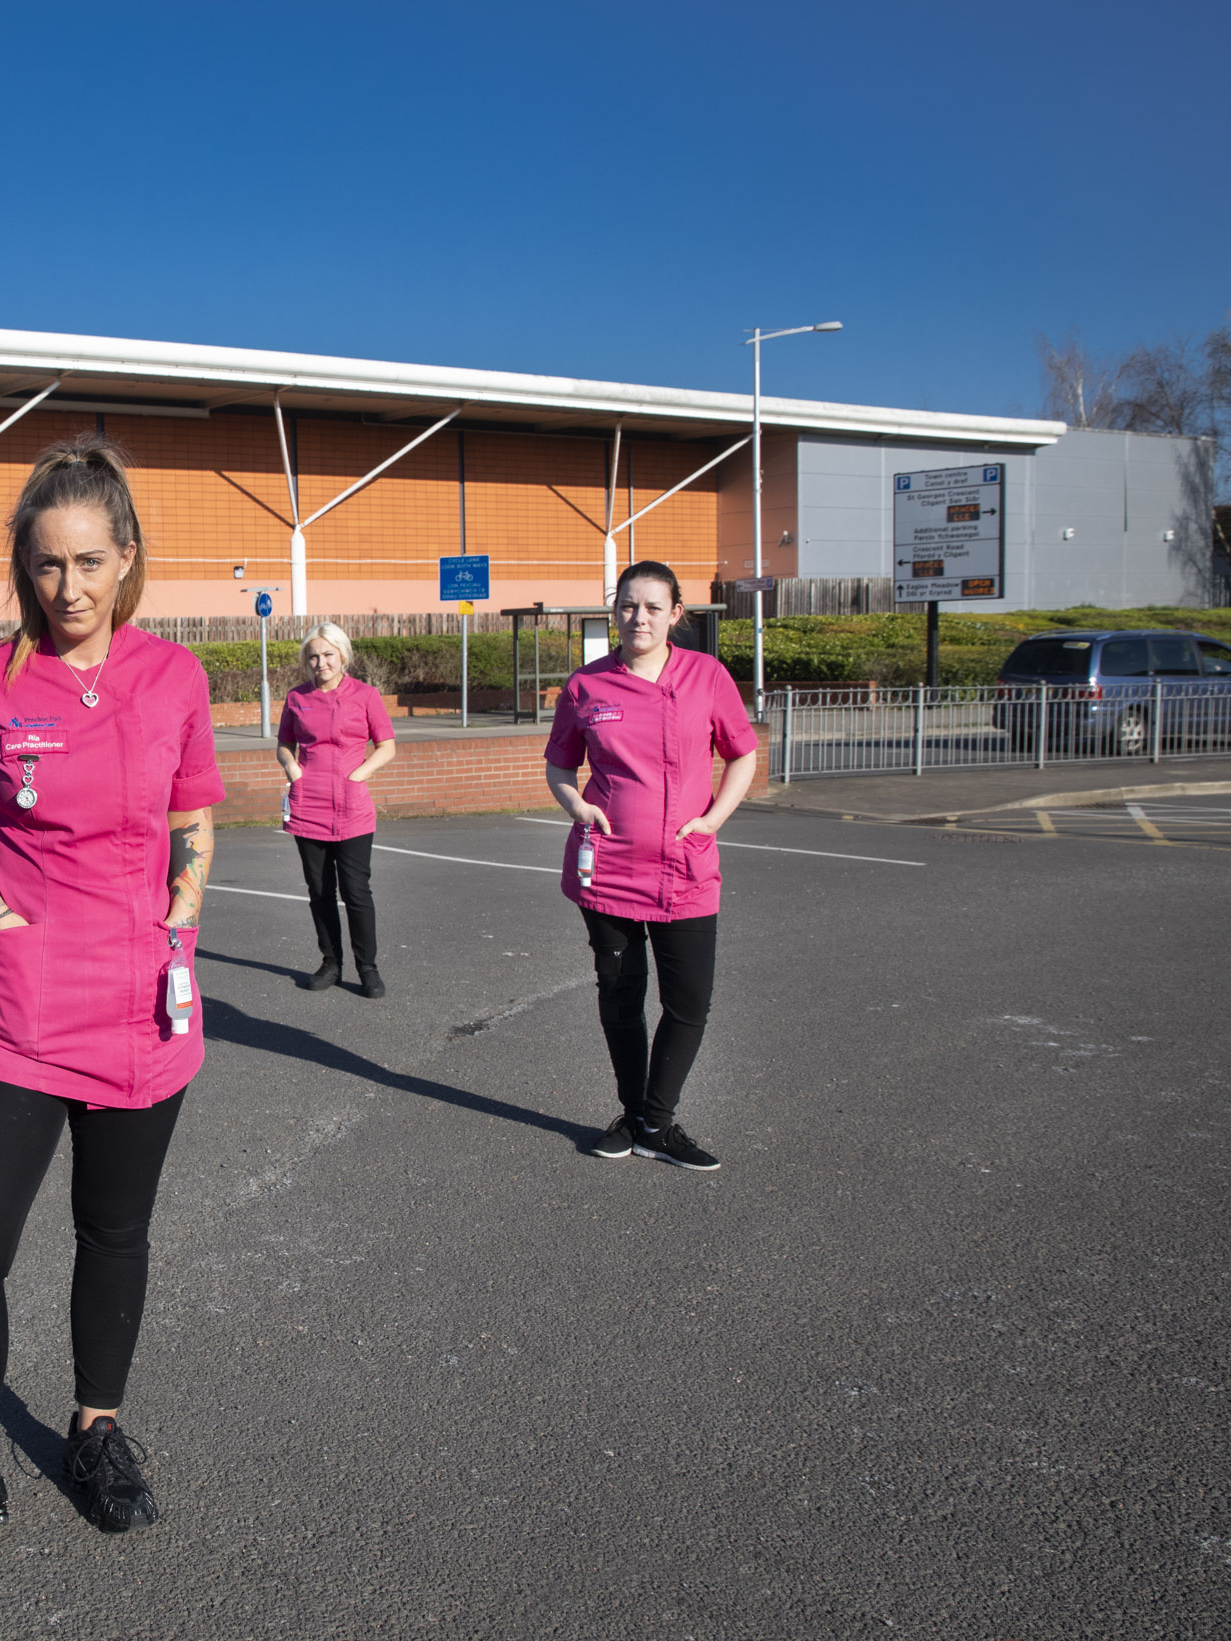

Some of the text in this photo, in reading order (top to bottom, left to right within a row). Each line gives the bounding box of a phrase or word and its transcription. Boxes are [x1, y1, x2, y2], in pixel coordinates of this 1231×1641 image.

[947, 489, 980, 497] Crescent
[914, 526, 948, 534] Additional
[912, 544, 943, 553] Crescent
[28, 734, 40, 742] Ria
[22, 741, 64, 749] Practitioner
